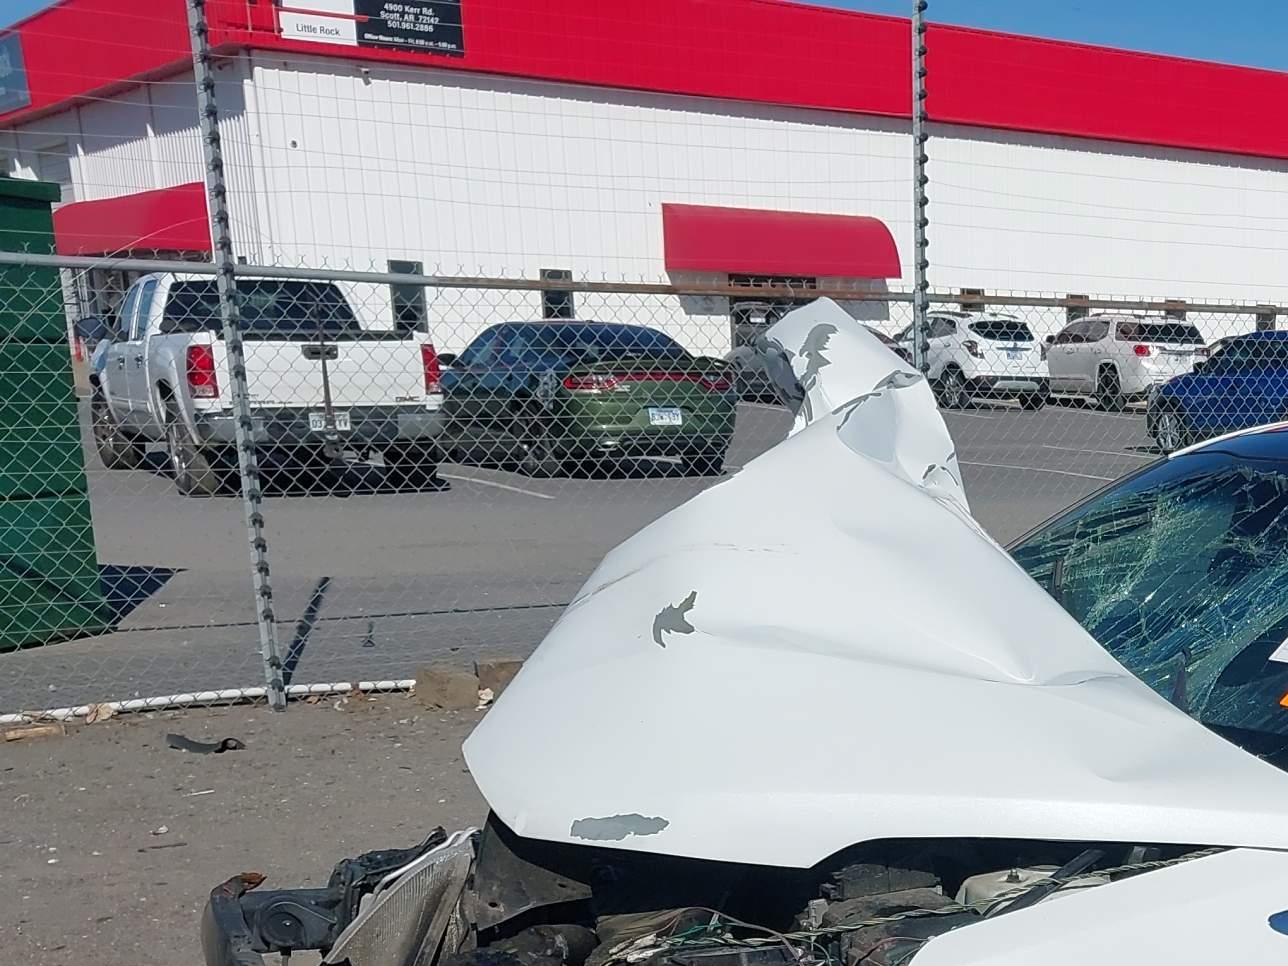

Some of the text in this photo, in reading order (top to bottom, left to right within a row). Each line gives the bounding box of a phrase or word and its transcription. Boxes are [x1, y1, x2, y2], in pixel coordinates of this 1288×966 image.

[404, 5, 421, 14] Kerr
[422, 7, 435, 15] Rd.
[380, 11, 440, 24] Scott, AR 72142
[296, 23, 340, 36] Little Rock
